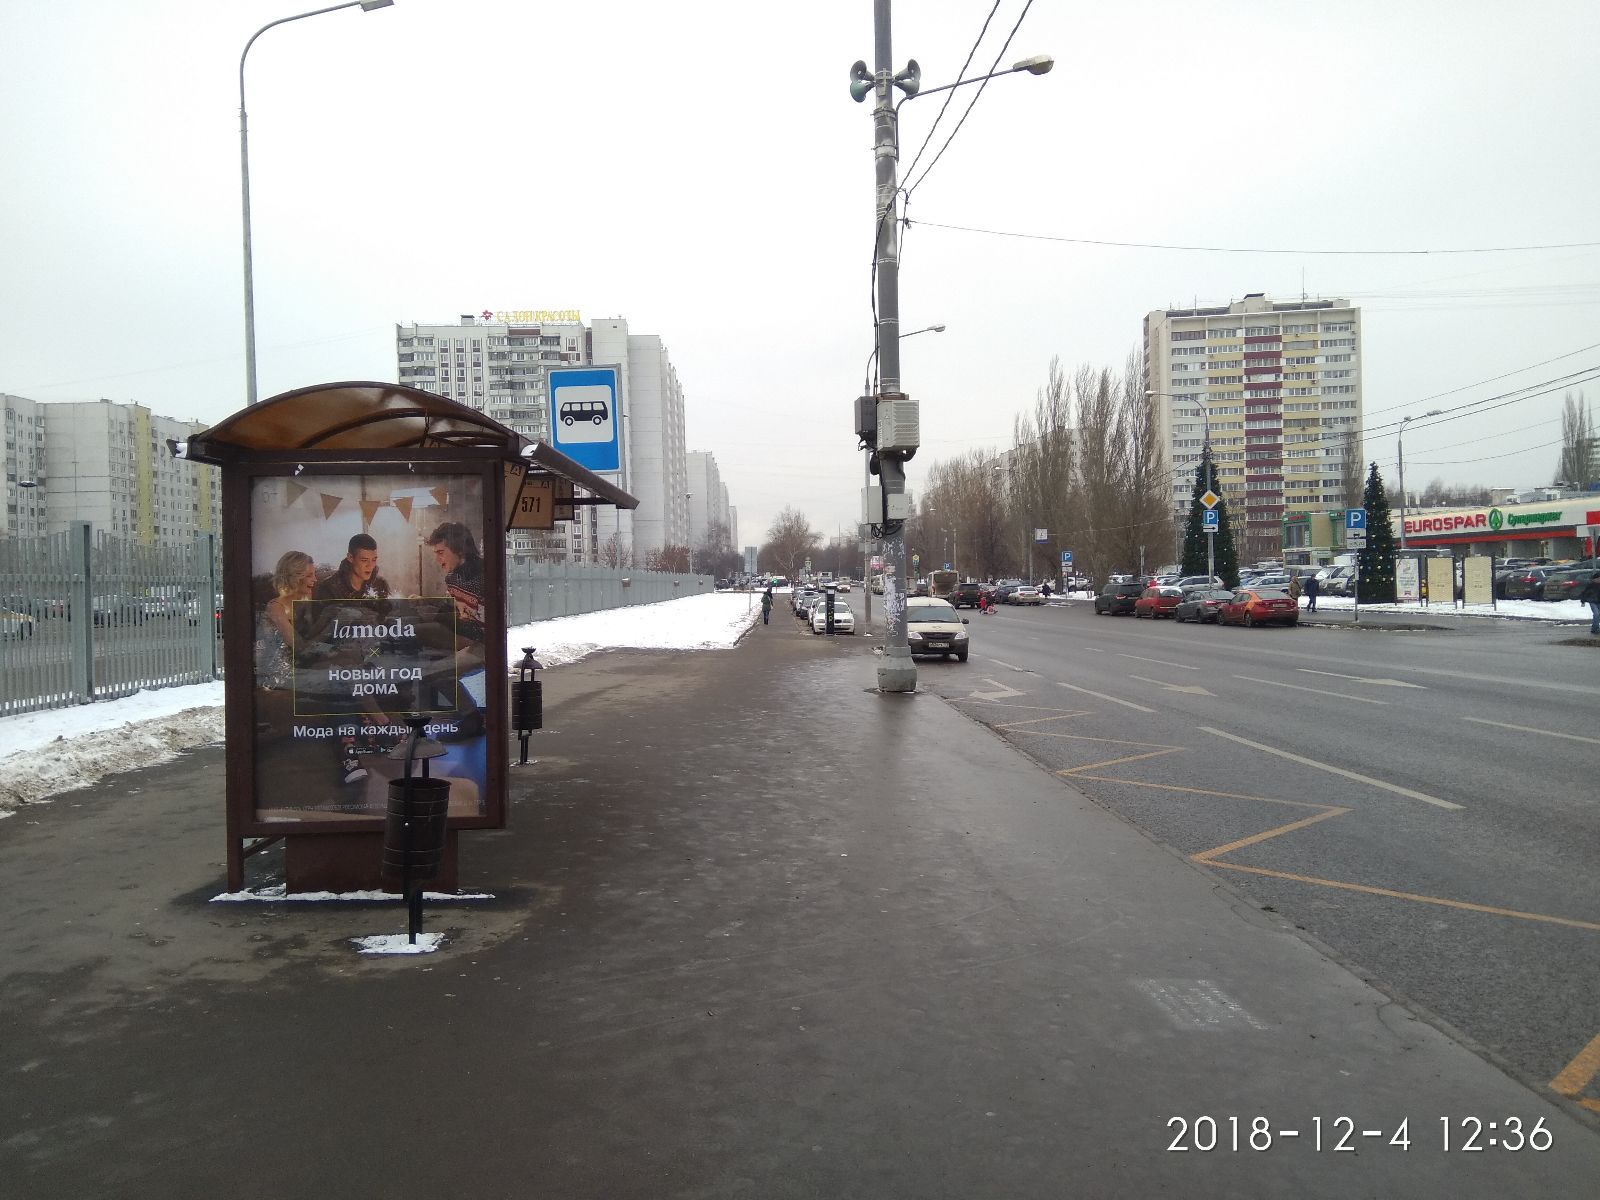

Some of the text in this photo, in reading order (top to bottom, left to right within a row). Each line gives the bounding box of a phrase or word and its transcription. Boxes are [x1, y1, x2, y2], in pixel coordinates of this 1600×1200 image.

[521, 497, 541, 512] 571
[1404, 513, 1487, 533] EUROSPAR
[333, 619, 416, 639] lamoda
[328, 667, 422, 681] НОВЫЙ ГОД
[352, 683, 398, 697] ДОМА
[293, 726, 334, 738] Мода
[338, 726, 356, 736] на
